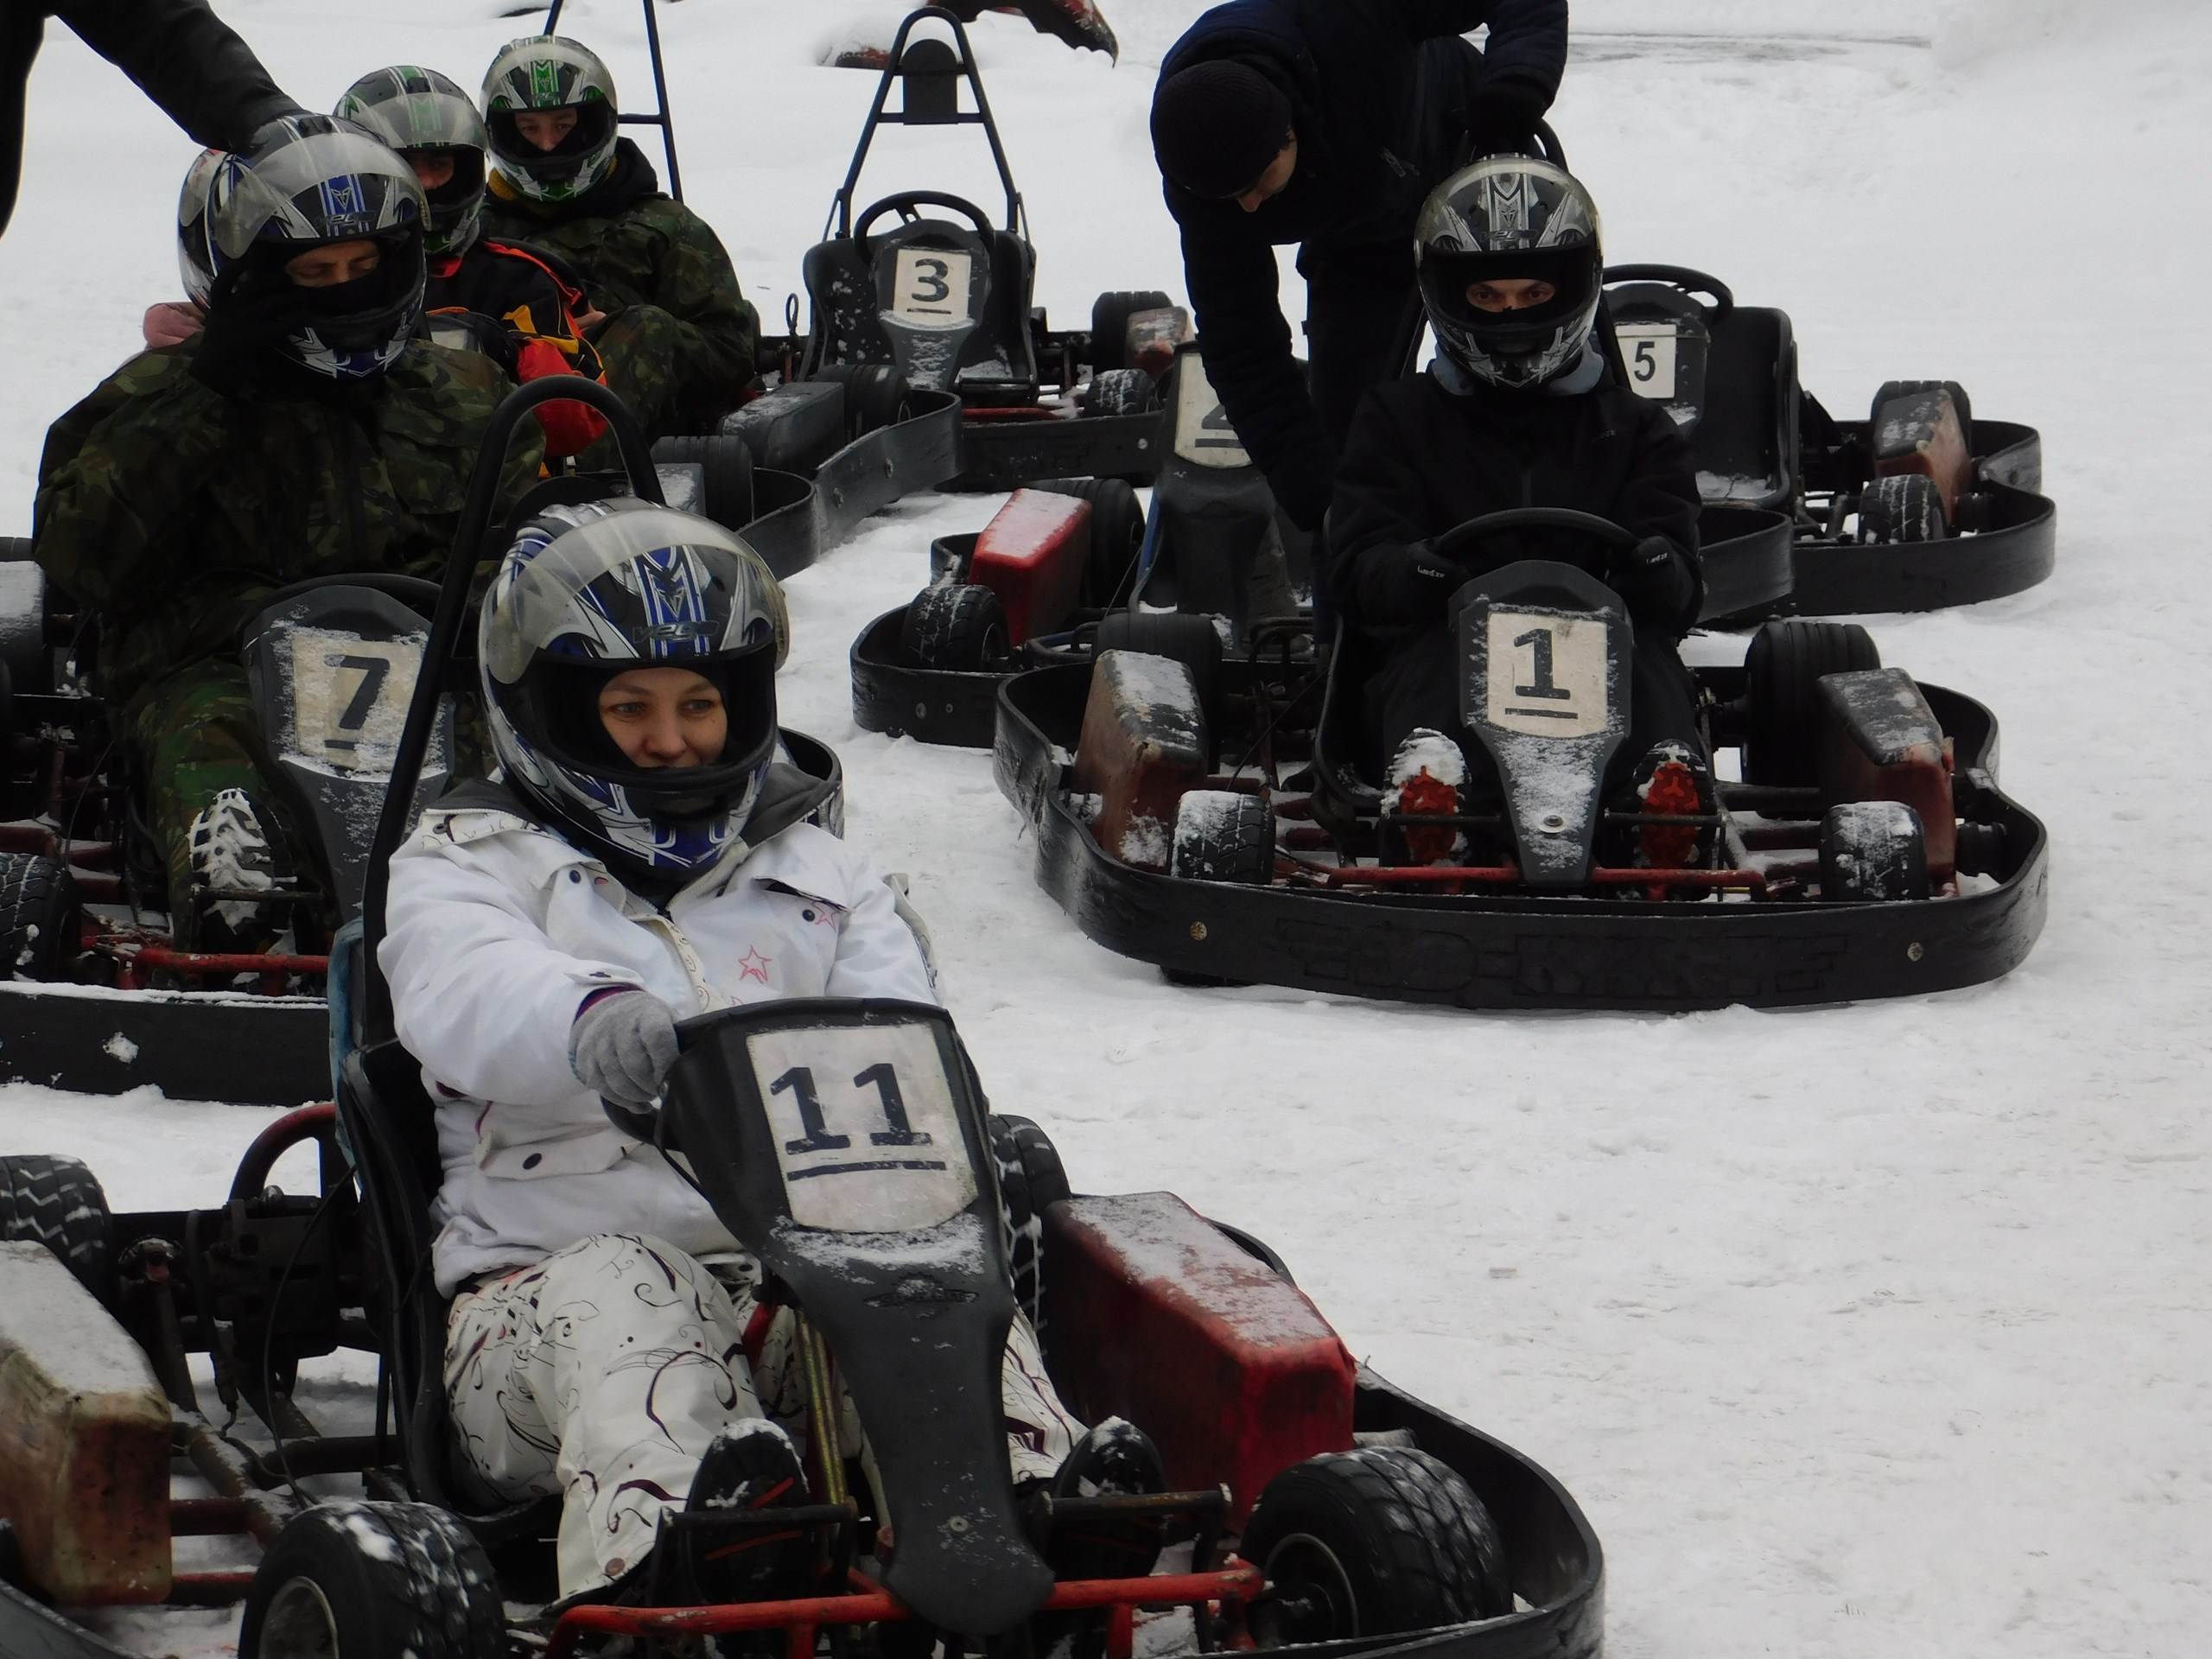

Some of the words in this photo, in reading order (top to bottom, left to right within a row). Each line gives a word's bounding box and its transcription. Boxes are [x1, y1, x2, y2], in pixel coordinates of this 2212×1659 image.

[912, 259, 949, 302] 3
[1633, 341, 1656, 382] 5
[324, 654, 391, 730] 7
[1514, 628, 1571, 700] 1
[771, 1063, 933, 1156] 11
